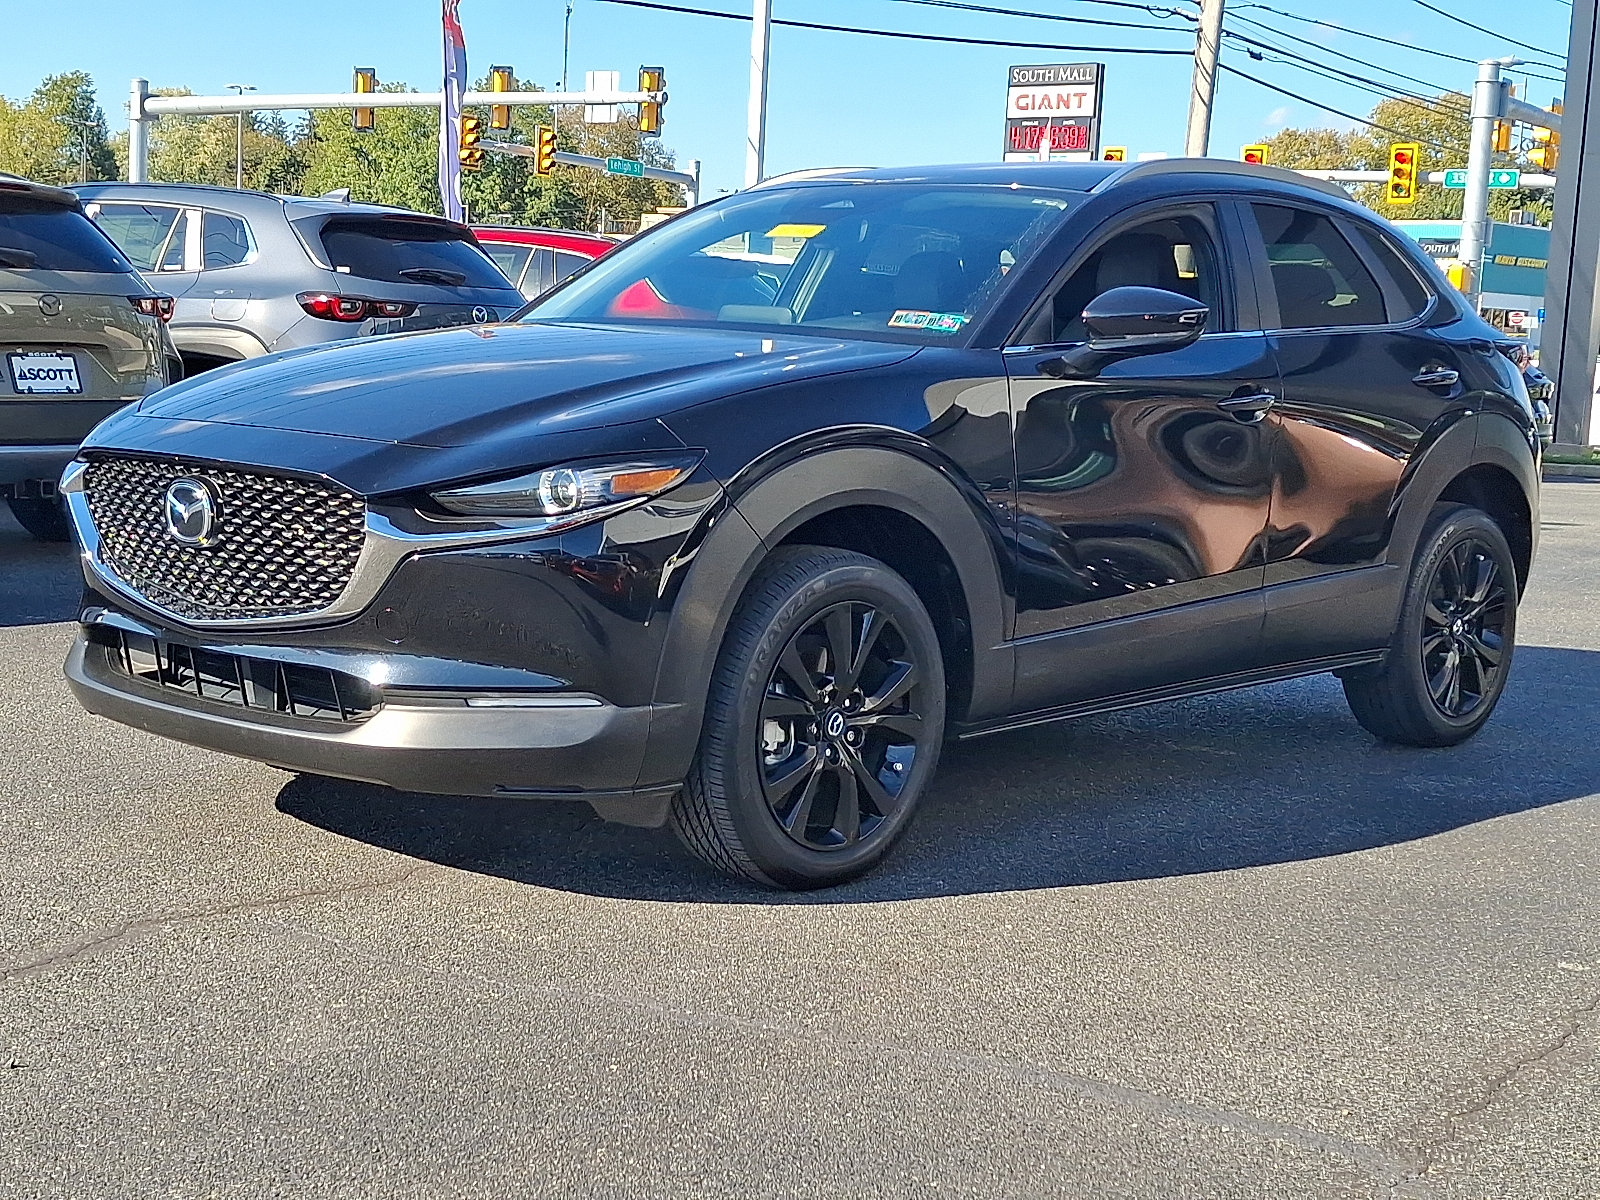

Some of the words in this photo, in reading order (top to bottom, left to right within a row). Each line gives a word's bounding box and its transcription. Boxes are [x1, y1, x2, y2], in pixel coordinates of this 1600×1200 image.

[1012, 68, 1054, 82] SOUTH
[1057, 66, 1093, 81] MALL
[1015, 92, 1087, 110] GIANT
[610, 160, 632, 173] Lehigh
[27, 367, 74, 381] SCOTT
